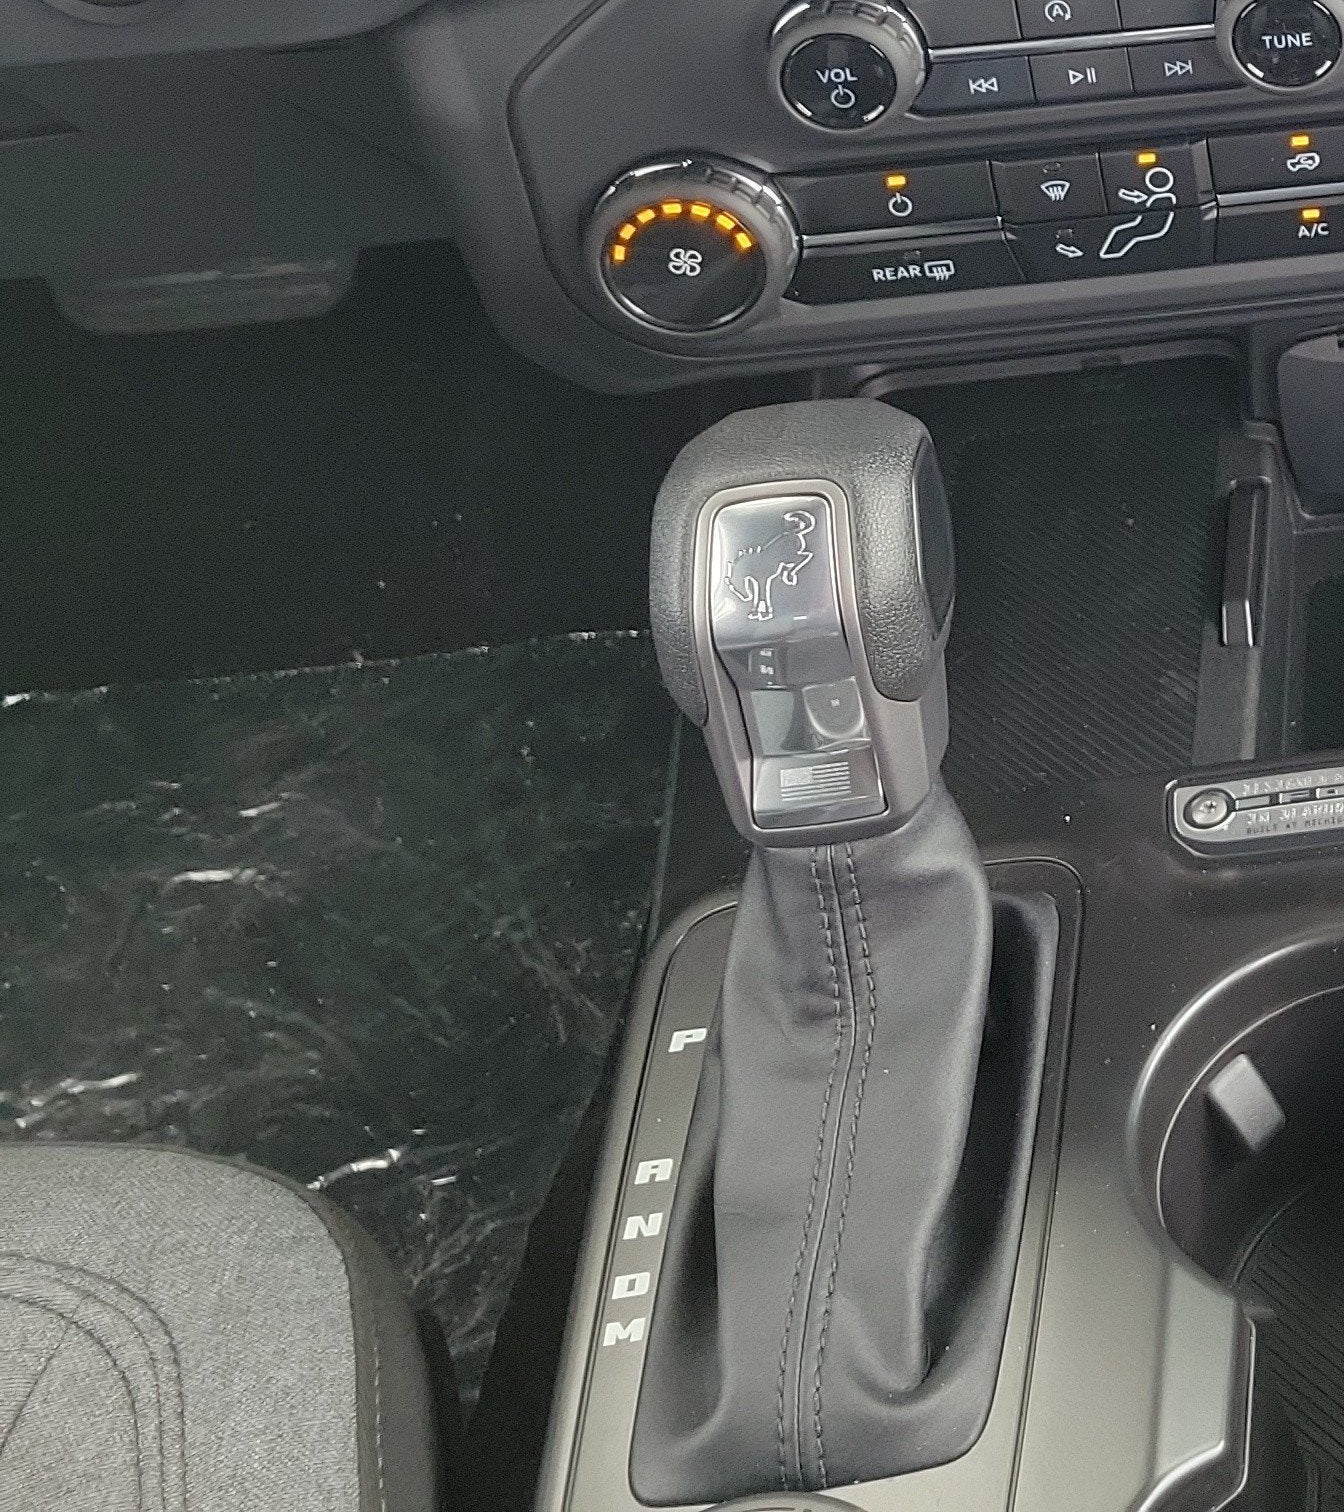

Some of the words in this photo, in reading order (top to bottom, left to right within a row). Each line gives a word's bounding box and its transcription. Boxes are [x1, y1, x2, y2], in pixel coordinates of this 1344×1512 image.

[1261, 32, 1313, 49] TUNE
[815, 67, 858, 84] VOL
[1296, 219, 1330, 239] A/C
[871, 264, 923, 283] REAR
[667, 1027, 707, 1053] P
[633, 1157, 674, 1185] A
[622, 1212, 664, 1241] N
[611, 1271, 651, 1300] D
[602, 1316, 647, 1347] M
